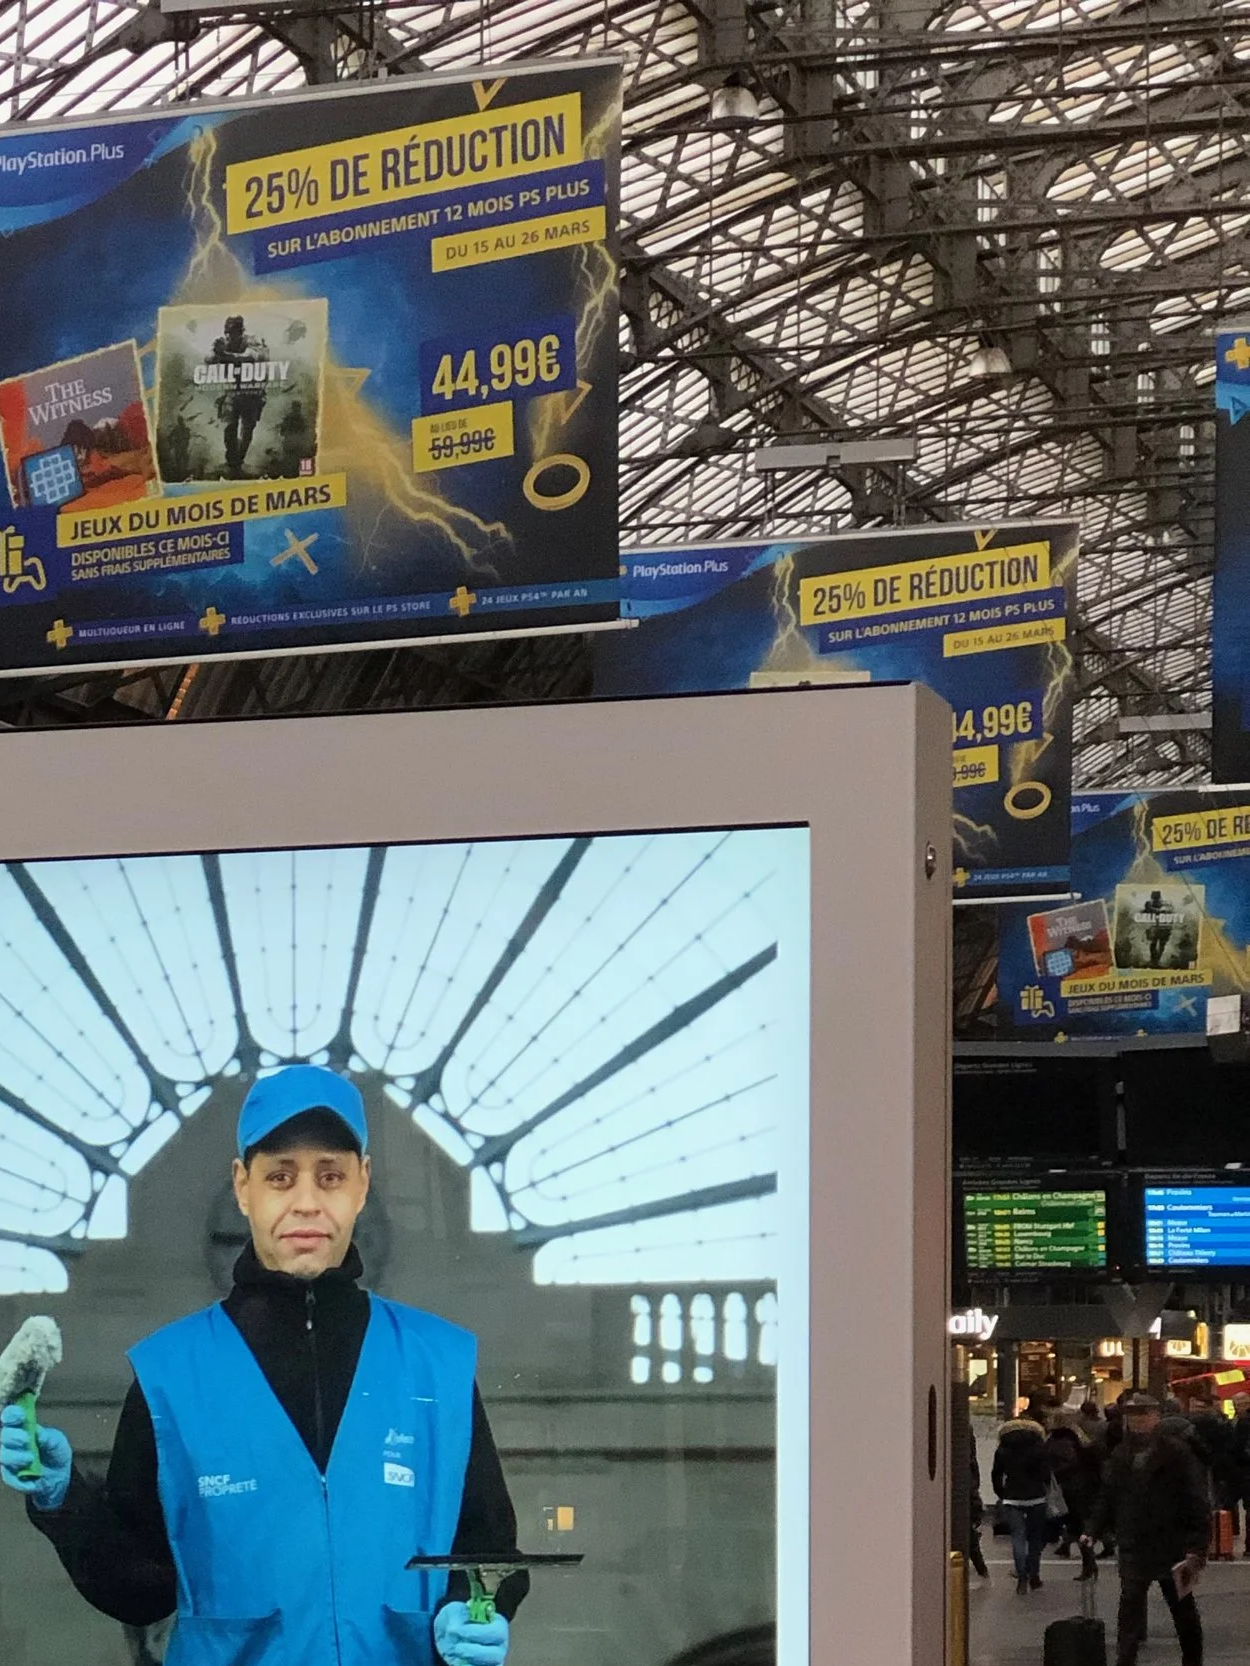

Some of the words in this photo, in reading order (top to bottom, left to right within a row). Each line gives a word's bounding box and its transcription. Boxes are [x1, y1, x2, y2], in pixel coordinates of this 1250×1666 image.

[91, 143, 125, 162] Plus
[244, 166, 319, 219] 25%
[330, 156, 371, 202] DE
[382, 112, 566, 192] RÉDUCTION
[267, 236, 301, 258] SUR
[305, 209, 440, 250] L'ABONNEMENT
[444, 204, 463, 222] 12
[467, 196, 514, 219] MOIS
[519, 191, 541, 208] PS
[546, 180, 590, 202] PLUS
[446, 245, 469, 260] DU
[473, 241, 489, 256] 15
[493, 235, 517, 252] AU
[521, 231, 540, 246] 26
[544, 220, 591, 242] MARS
[431, 334, 561, 400] 44,99€
[28, 387, 113, 427] WITNESS
[45, 379, 86, 404] THE
[429, 427, 496, 461] 59,99€
[71, 516, 123, 541] JEUX
[129, 509, 160, 533] DU
[166, 500, 224, 526] MOIS
[231, 495, 259, 516] DE
[266, 484, 332, 511] MARS
[71, 538, 156, 566] DISPONIBLES
[158, 538, 175, 554] CE
[178, 531, 230, 551] MOIS-CI
[633, 563, 702, 581] PlayStation
[704, 560, 729, 573] Plus
[813, 583, 866, 616] 25%
[874, 575, 901, 607] DE
[910, 554, 1038, 602] RÉDUCTION
[1162, 821, 1202, 846] 25%
[1206, 816, 1227, 839] DE
[1068, 982, 1096, 994] JEUX
[1098, 980, 1116, 991] DU
[1119, 977, 1150, 990] MOIS
[1152, 977, 1167, 987] DE
[1170, 973, 1204, 986] MARS
[198, 1474, 231, 1487] SNCF
